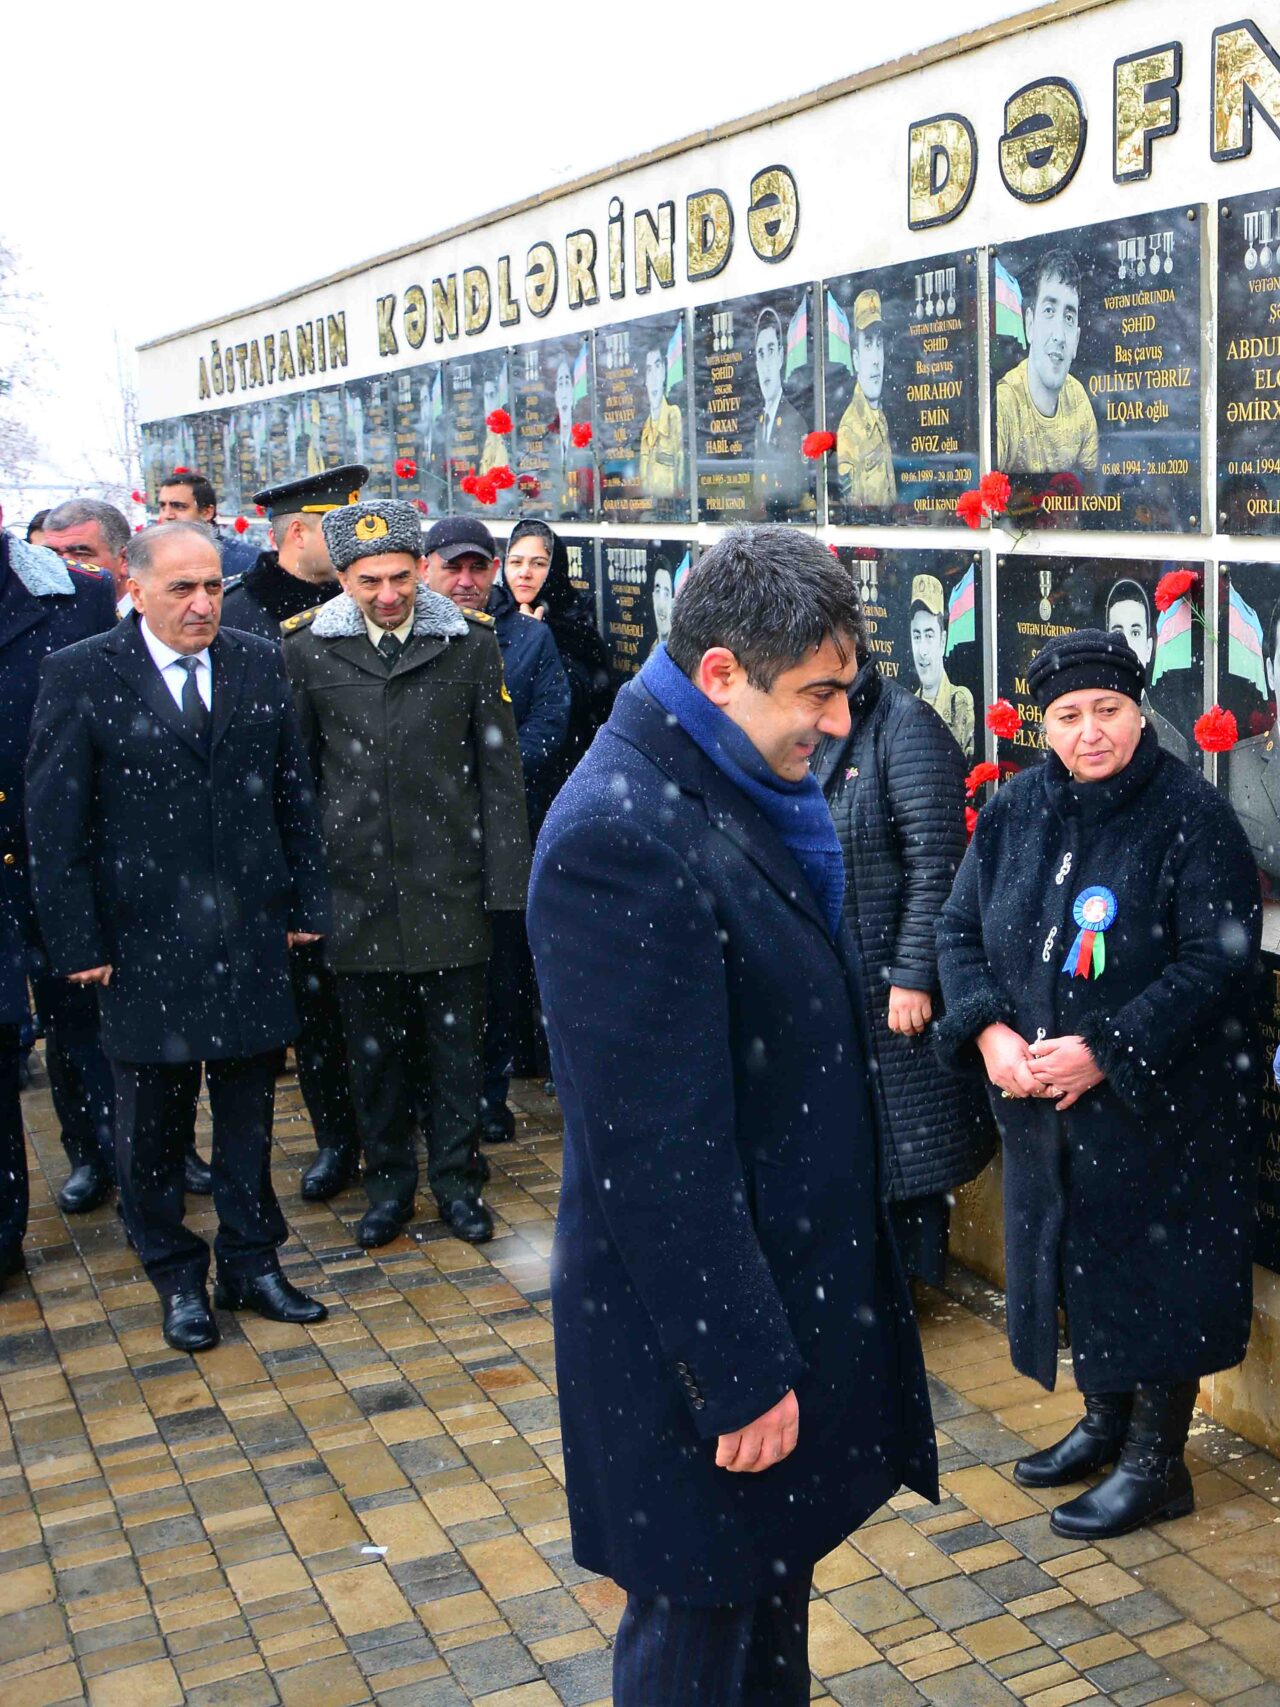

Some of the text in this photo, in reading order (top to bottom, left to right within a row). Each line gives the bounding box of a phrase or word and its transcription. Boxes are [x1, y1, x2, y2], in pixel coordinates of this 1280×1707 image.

[199, 311, 348, 400] AĞSTAFANIN
[376, 164, 801, 356] KƏNDLƏRİNDƏ
[1248, 275, 1280, 294] VƏTƏN
[1121, 315, 1156, 334] ŞƏHİD
[923, 336, 949, 353] ŞƏHİD
[1114, 347, 1132, 365] Baş
[1089, 367, 1191, 395] QULİYEV TƏBRİZ
[907, 381, 963, 402] ƏMRAHOV
[920, 407, 950, 428] EMİN
[1106, 399, 1169, 423] İLQAR oğlu
[1228, 457, 1280, 474] 01.04.1994
[1081, 493, 1122, 511] KƏNDİ
[1247, 498, 1280, 517] QIRLI
[870, 639, 892, 656] AVUŞ
